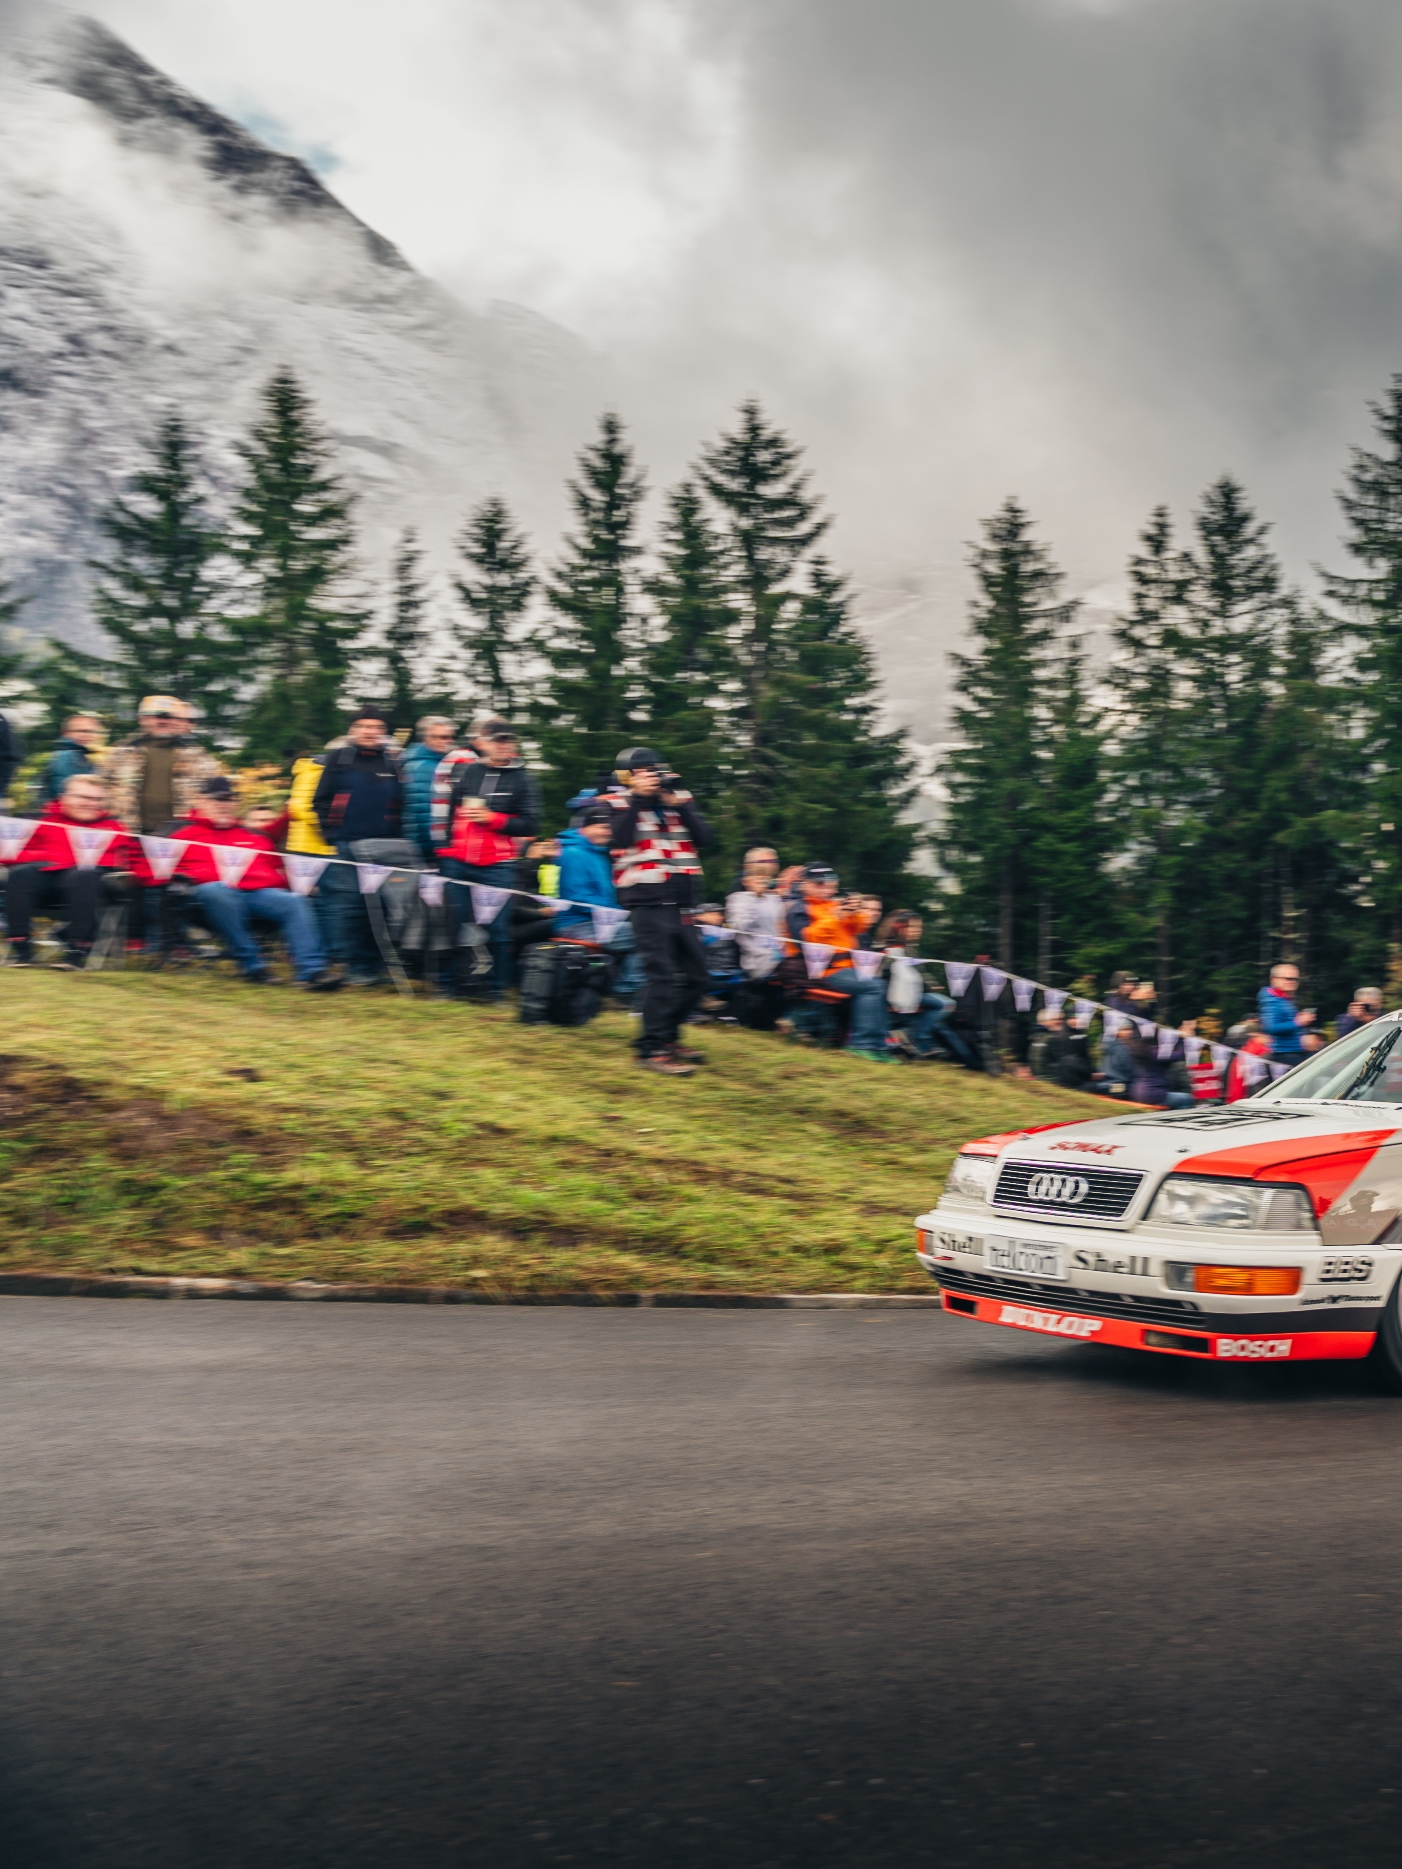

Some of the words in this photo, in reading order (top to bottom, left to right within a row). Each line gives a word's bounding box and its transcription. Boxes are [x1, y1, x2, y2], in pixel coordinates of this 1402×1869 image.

[934, 1230, 984, 1257] Shell
[1071, 1249, 1150, 1277] Shell
[1316, 1255, 1375, 1282] BBS
[998, 1305, 1104, 1337] DUNLOP
[1216, 1337, 1293, 1358] BOSCH
